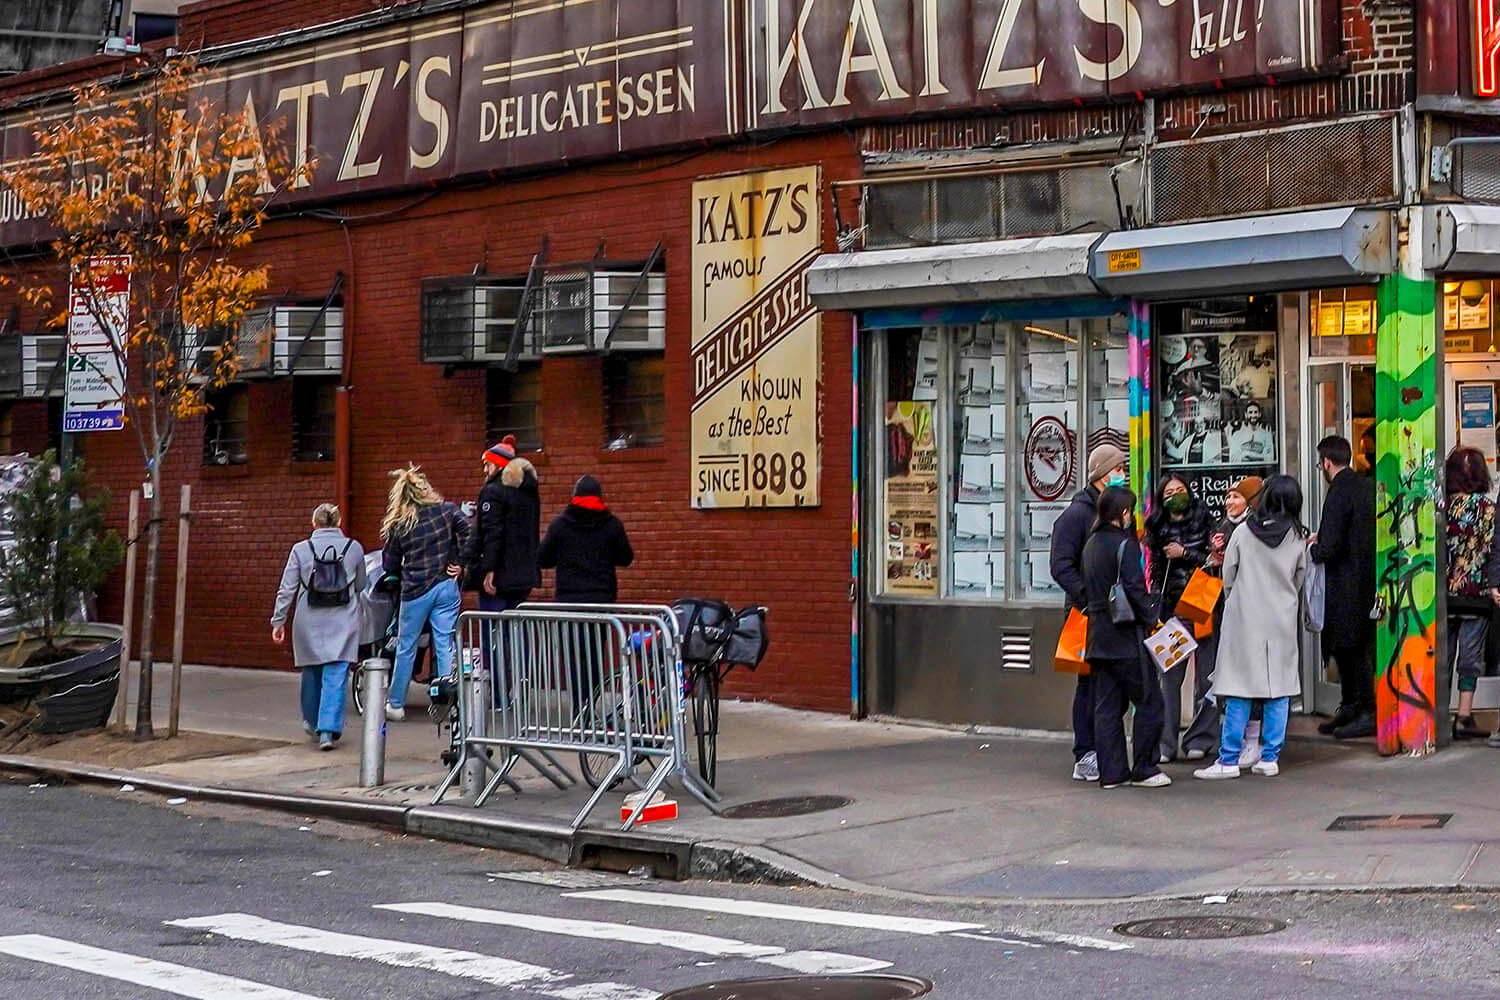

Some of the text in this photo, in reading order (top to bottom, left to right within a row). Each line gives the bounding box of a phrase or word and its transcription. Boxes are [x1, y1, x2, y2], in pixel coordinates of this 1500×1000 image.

[478, 63, 696, 144] DELICATESSEN
[696, 183, 810, 245] KATZ'S
[71, 355, 83, 371] 2
[741, 375, 802, 401] KNOWN
[66, 418, 100, 429] 103739
[708, 406, 793, 439] as the Best
[698, 469, 741, 492] SINCE
